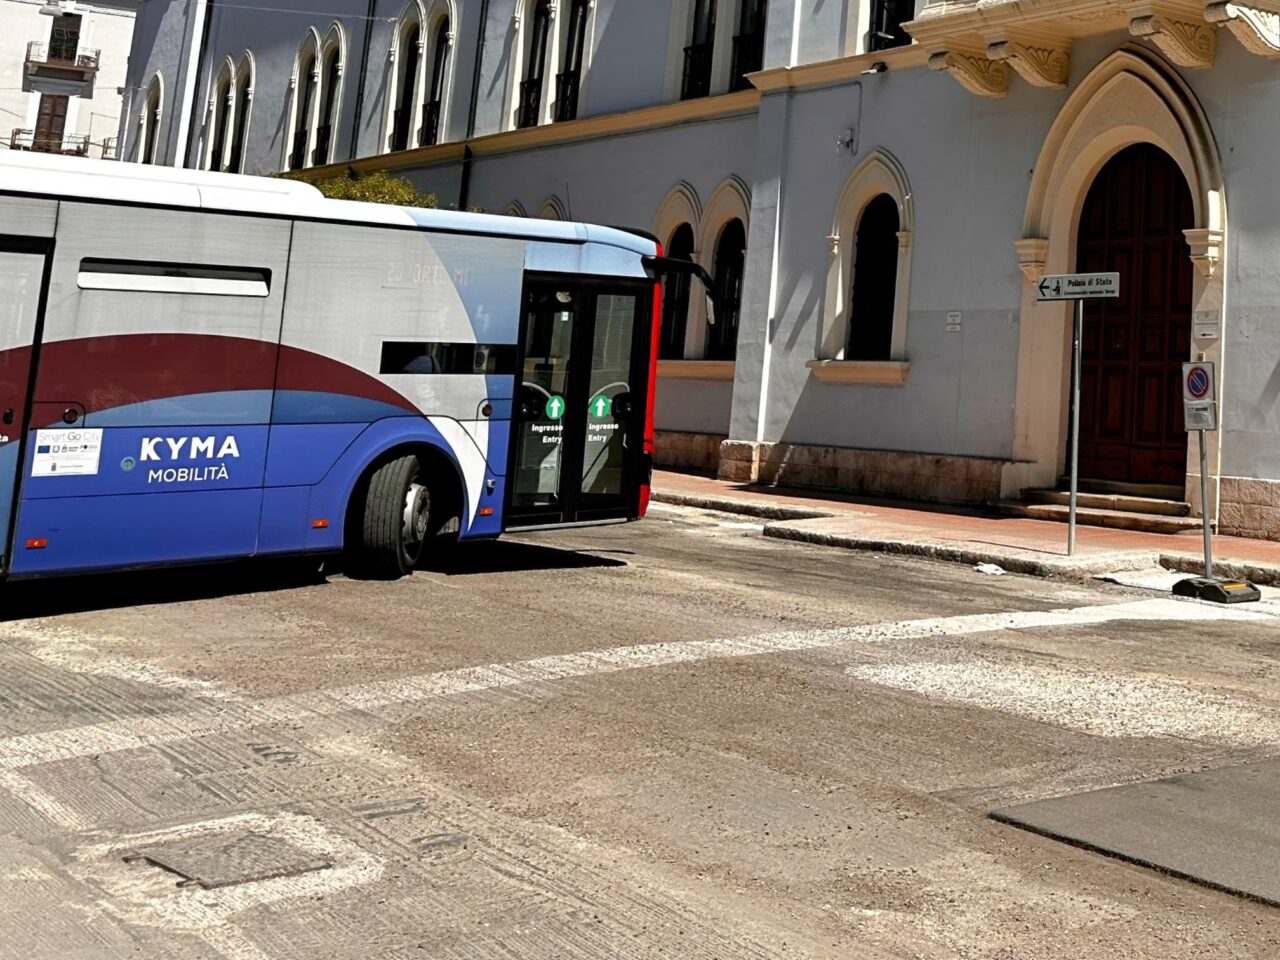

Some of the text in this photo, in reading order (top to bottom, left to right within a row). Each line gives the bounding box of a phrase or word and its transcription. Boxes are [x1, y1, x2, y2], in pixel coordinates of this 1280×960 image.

[532, 423, 563, 433] Ingresso
[589, 422, 619, 432] Ingresso
[39, 431, 99, 443] Smart Go City
[542, 435, 562, 445] Entry
[588, 433, 607, 443] Entry
[140, 435, 240, 461] KYMA
[148, 463, 229, 484] MOBILITÀ
